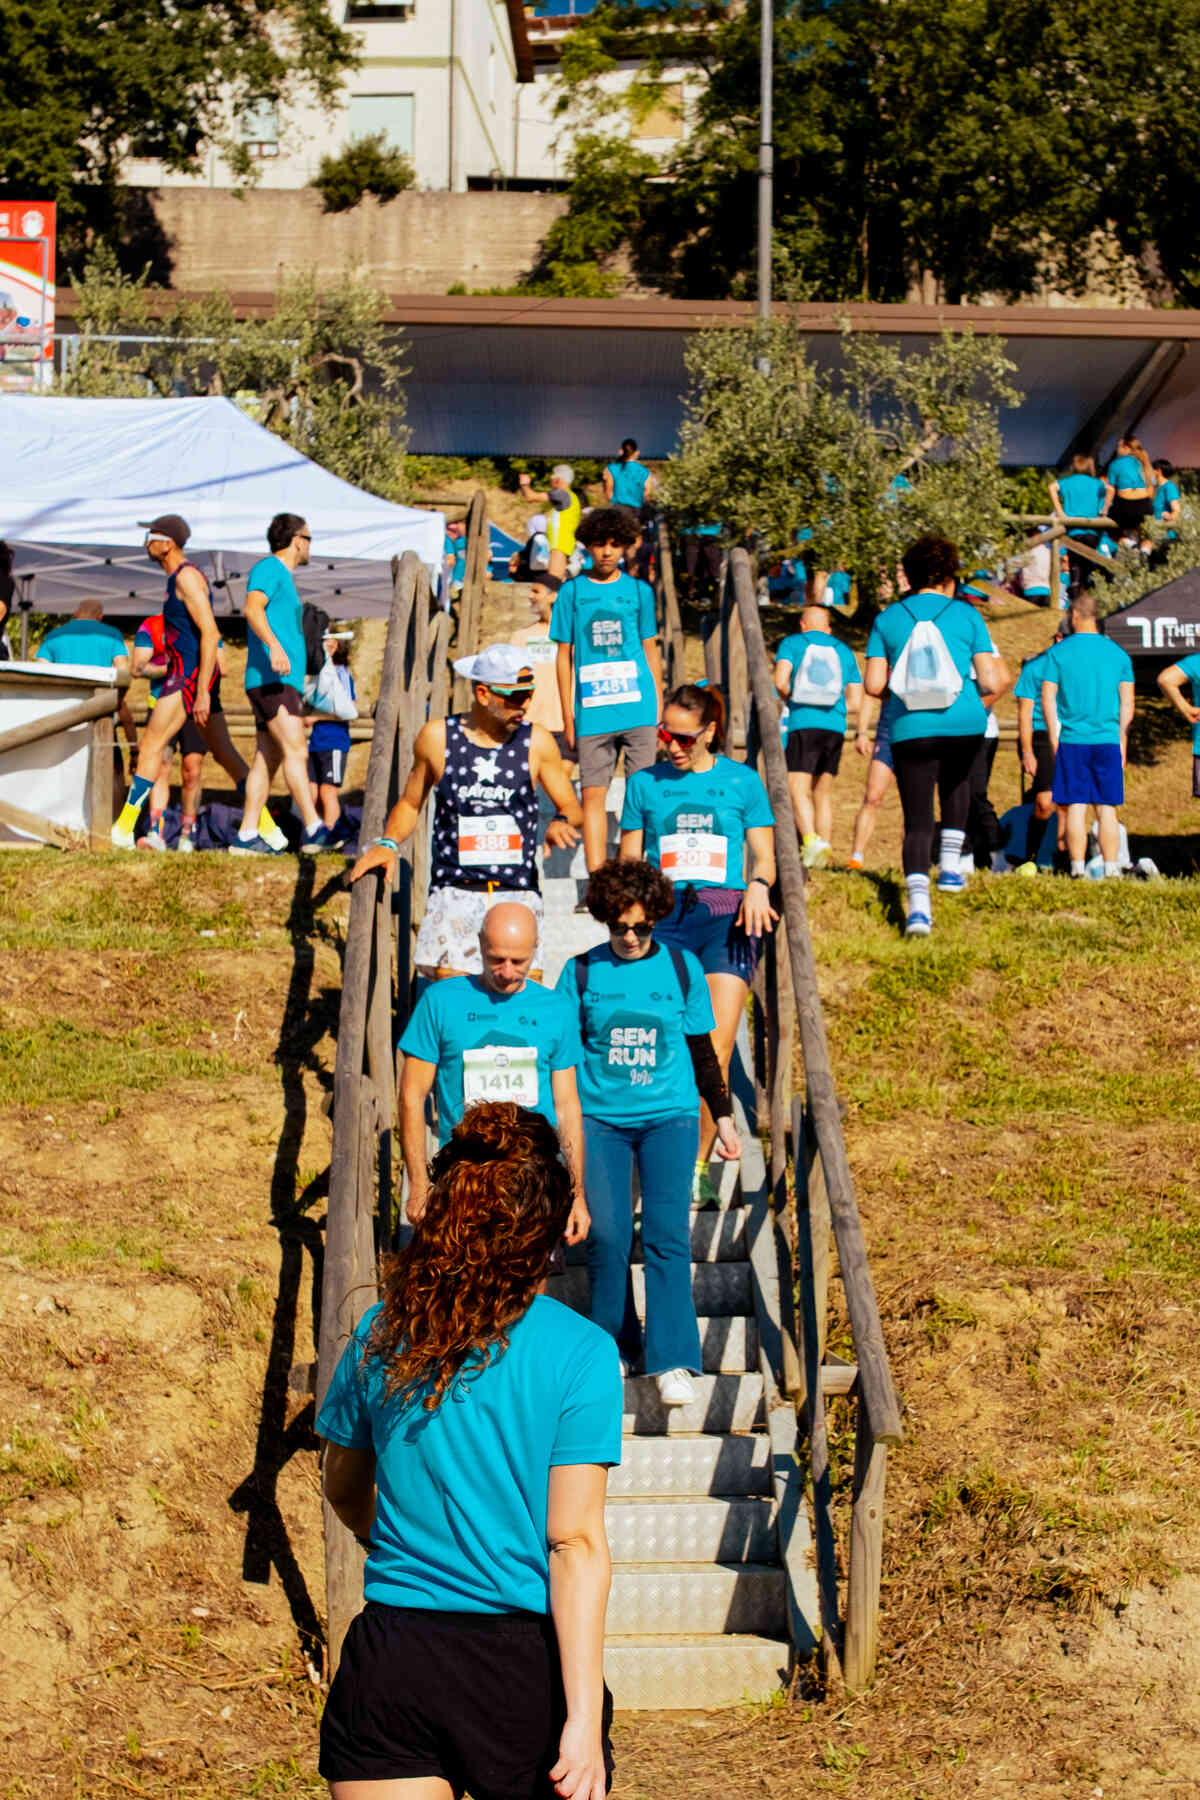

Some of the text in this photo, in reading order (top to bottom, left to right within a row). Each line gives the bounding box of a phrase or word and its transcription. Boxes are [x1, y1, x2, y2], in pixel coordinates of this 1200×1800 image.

[676, 813, 713, 828] SEM
[610, 1027, 657, 1047] SEM
[608, 1047, 656, 1067] RUN
[480, 1074, 525, 1091] 1414
